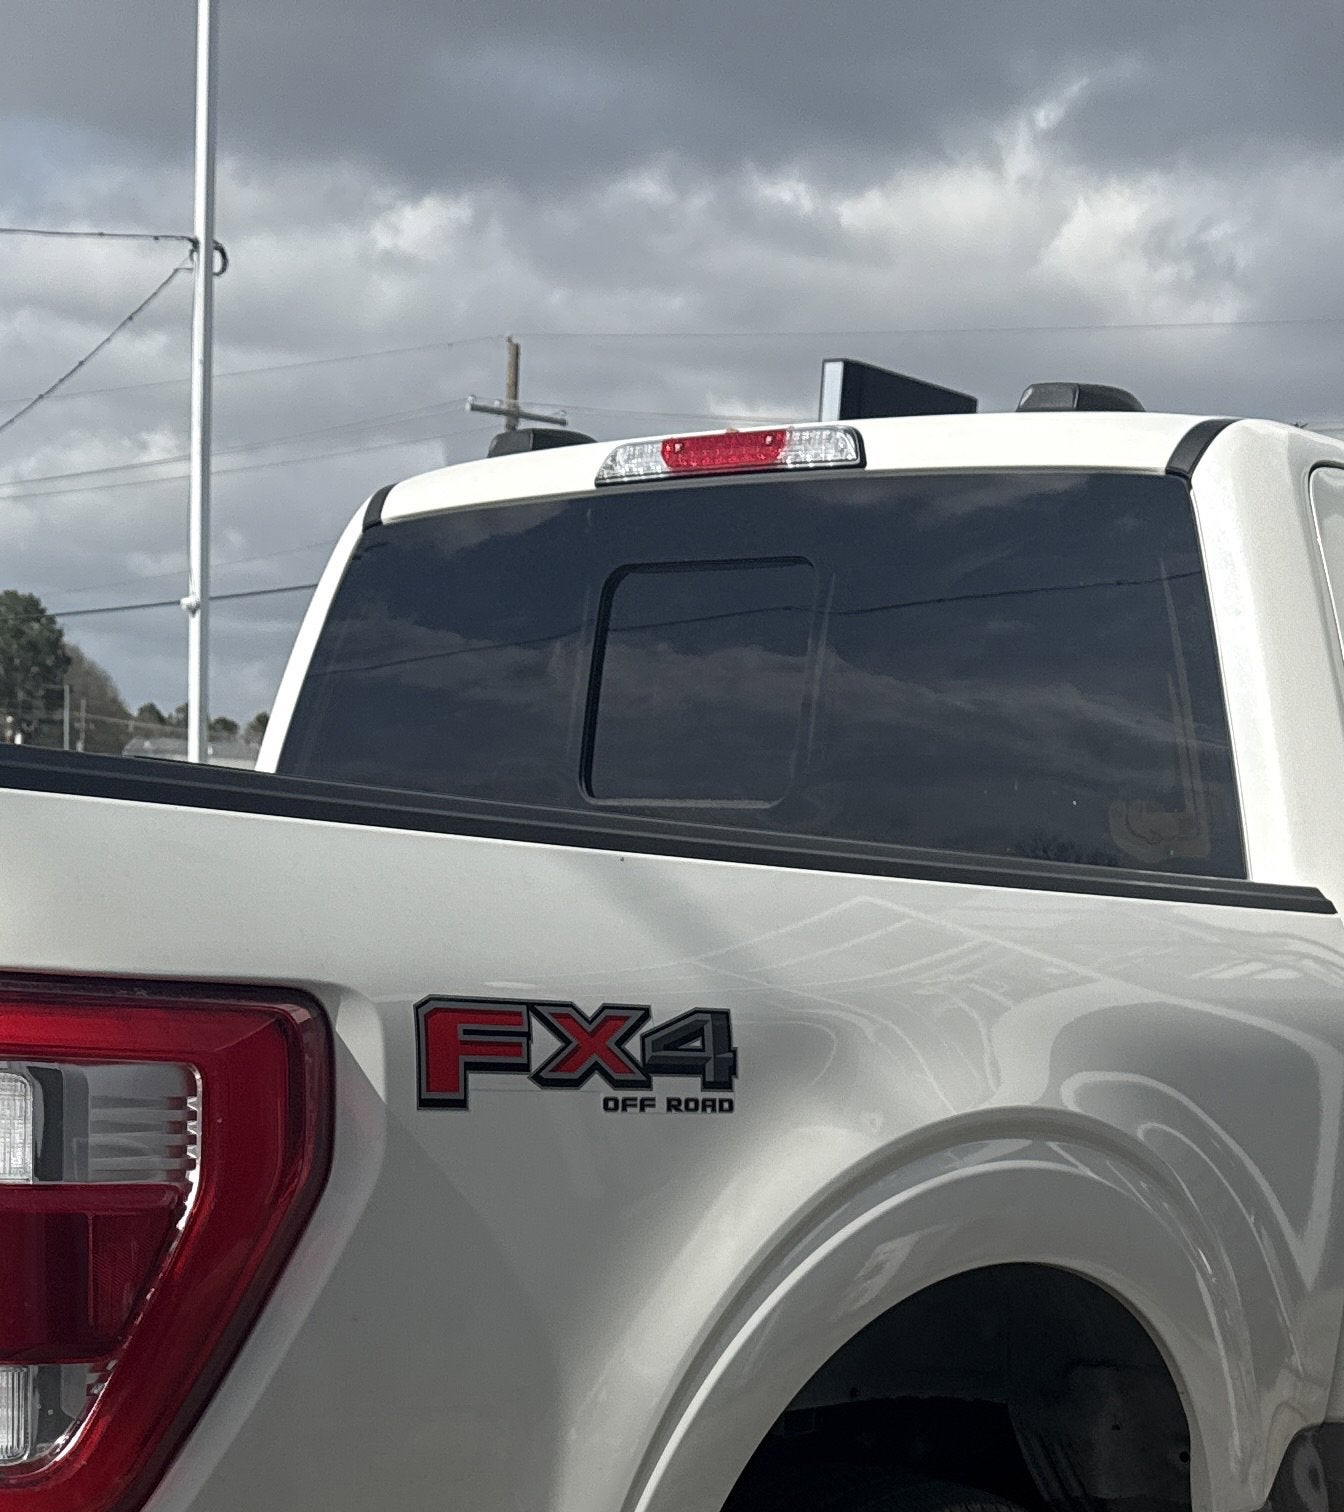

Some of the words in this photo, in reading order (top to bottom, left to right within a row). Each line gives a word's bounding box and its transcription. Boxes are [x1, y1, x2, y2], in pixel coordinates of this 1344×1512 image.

[413, 994, 738, 1112] FX4
[602, 1096, 657, 1113] OFF
[665, 1096, 734, 1114] ROAD
